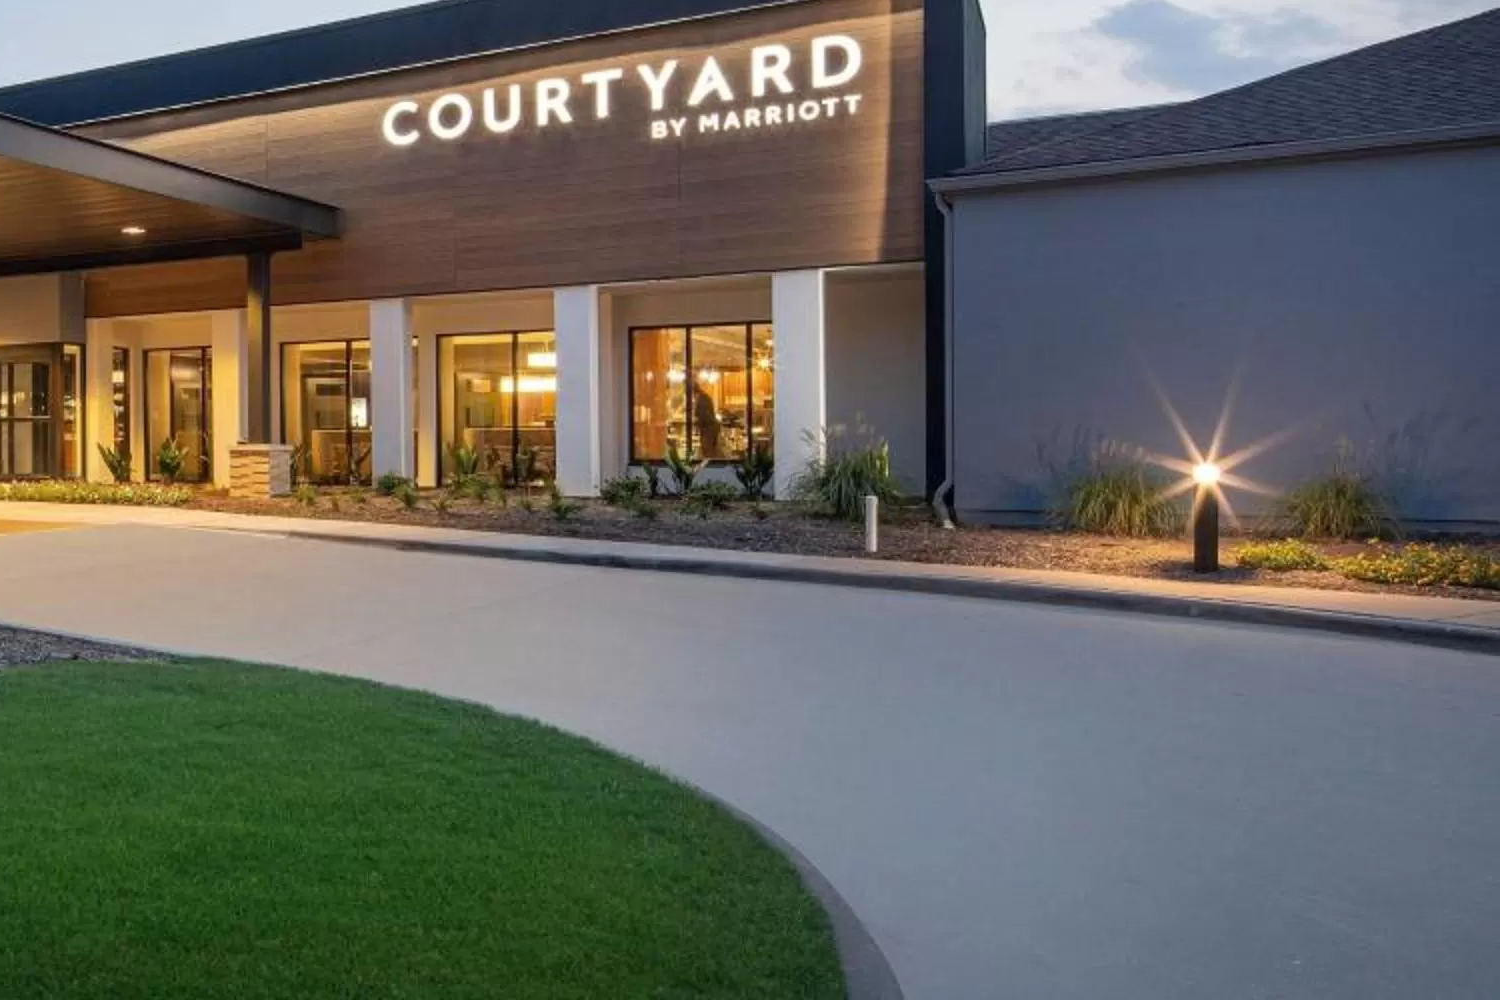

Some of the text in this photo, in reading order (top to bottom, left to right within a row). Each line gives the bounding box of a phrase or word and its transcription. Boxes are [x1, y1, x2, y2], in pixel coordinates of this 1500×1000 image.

[382, 34, 863, 147] COURTYARD
[650, 94, 863, 140] BY MARRIOTT
